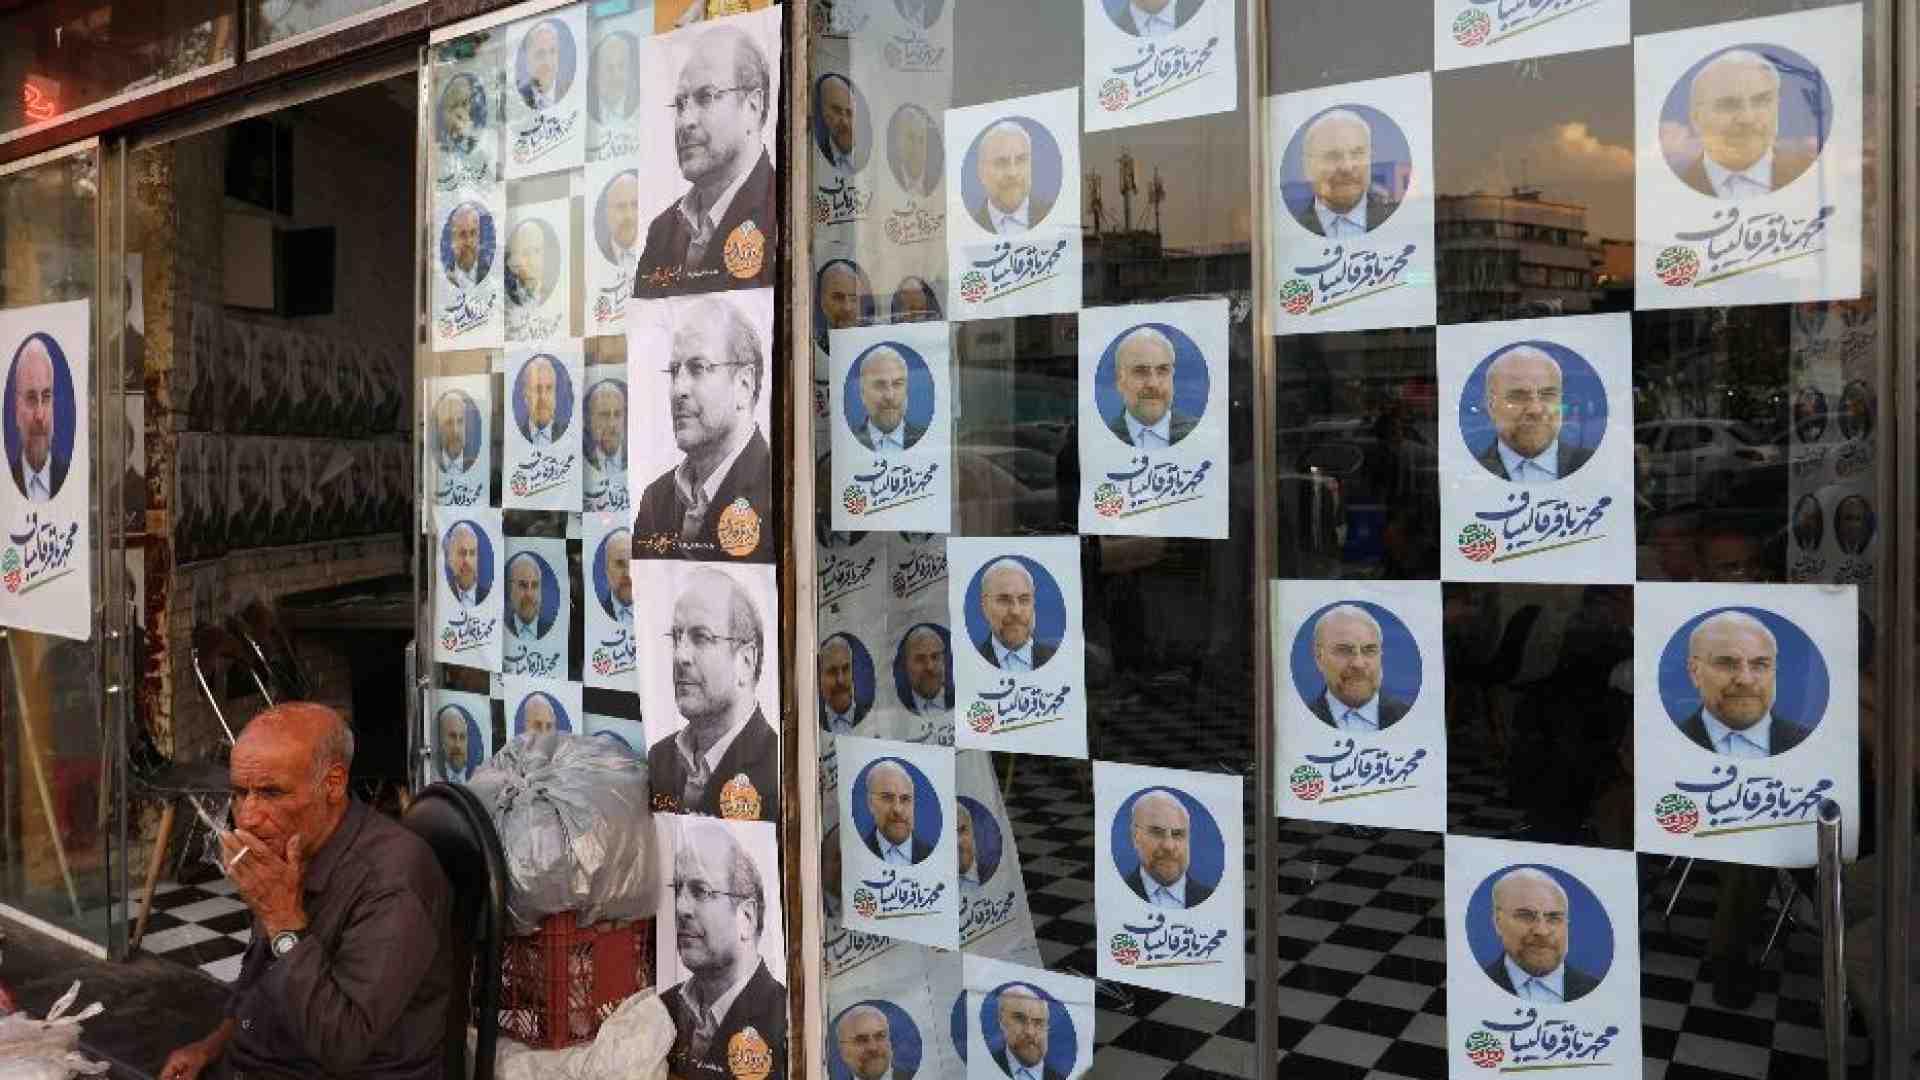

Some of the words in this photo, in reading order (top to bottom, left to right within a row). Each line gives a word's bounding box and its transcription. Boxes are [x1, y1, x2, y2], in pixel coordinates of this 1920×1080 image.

[1675, 207, 1768, 272] قالیباف
[1747, 214, 1791, 262] باقر
[1786, 206, 1835, 249] محمد
[1294, 245, 1366, 303] قالیباف
[1350, 252, 1383, 292] باقر
[1377, 244, 1416, 283] محمد
[1106, 455, 1169, 508] قالیباف
[1156, 464, 1183, 499] باقر
[1180, 460, 1212, 494] محمد
[1475, 491, 1557, 551] قالیباف
[1538, 502, 1576, 542] باقر
[1570, 496, 1613, 535] محمد
[1304, 738, 1377, 792] قالیباف
[1360, 751, 1393, 786] باقر
[1389, 749, 1426, 783] محمد
[1675, 765, 1767, 826] قالیباف
[1745, 780, 1792, 821] باقر
[1783, 779, 1834, 819] محمد
[861, 870, 909, 912] قالیباف
[901, 882, 923, 909] باقر
[920, 883, 945, 909] محمد
[959, 896, 986, 940] قالیبف
[1123, 913, 1184, 960] قالیباف
[1170, 928, 1201, 959] باقر
[1195, 930, 1227, 959] محمد
[1482, 1007, 1562, 1063] قالیباف
[1545, 1024, 1583, 1060] باقر
[1576, 1026, 1619, 1060] محمد
